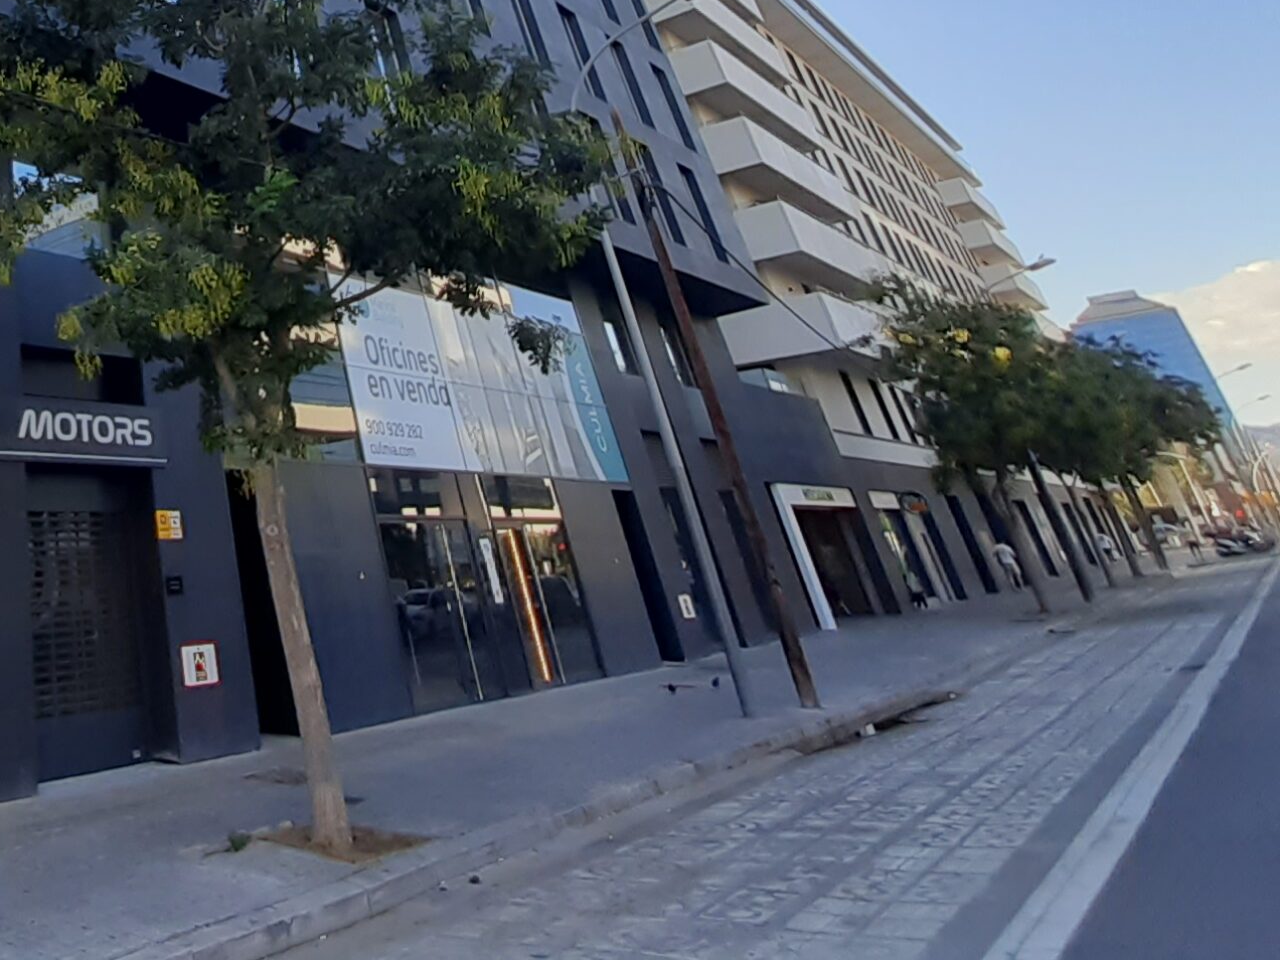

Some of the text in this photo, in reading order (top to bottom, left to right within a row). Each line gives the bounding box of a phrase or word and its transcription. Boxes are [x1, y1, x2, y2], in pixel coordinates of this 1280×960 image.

[363, 334, 440, 375] Oficines
[367, 374, 452, 408] en venda
[574, 362, 608, 454] CULMIA
[18, 408, 153, 447] MOTORS
[365, 418, 386, 436] 900
